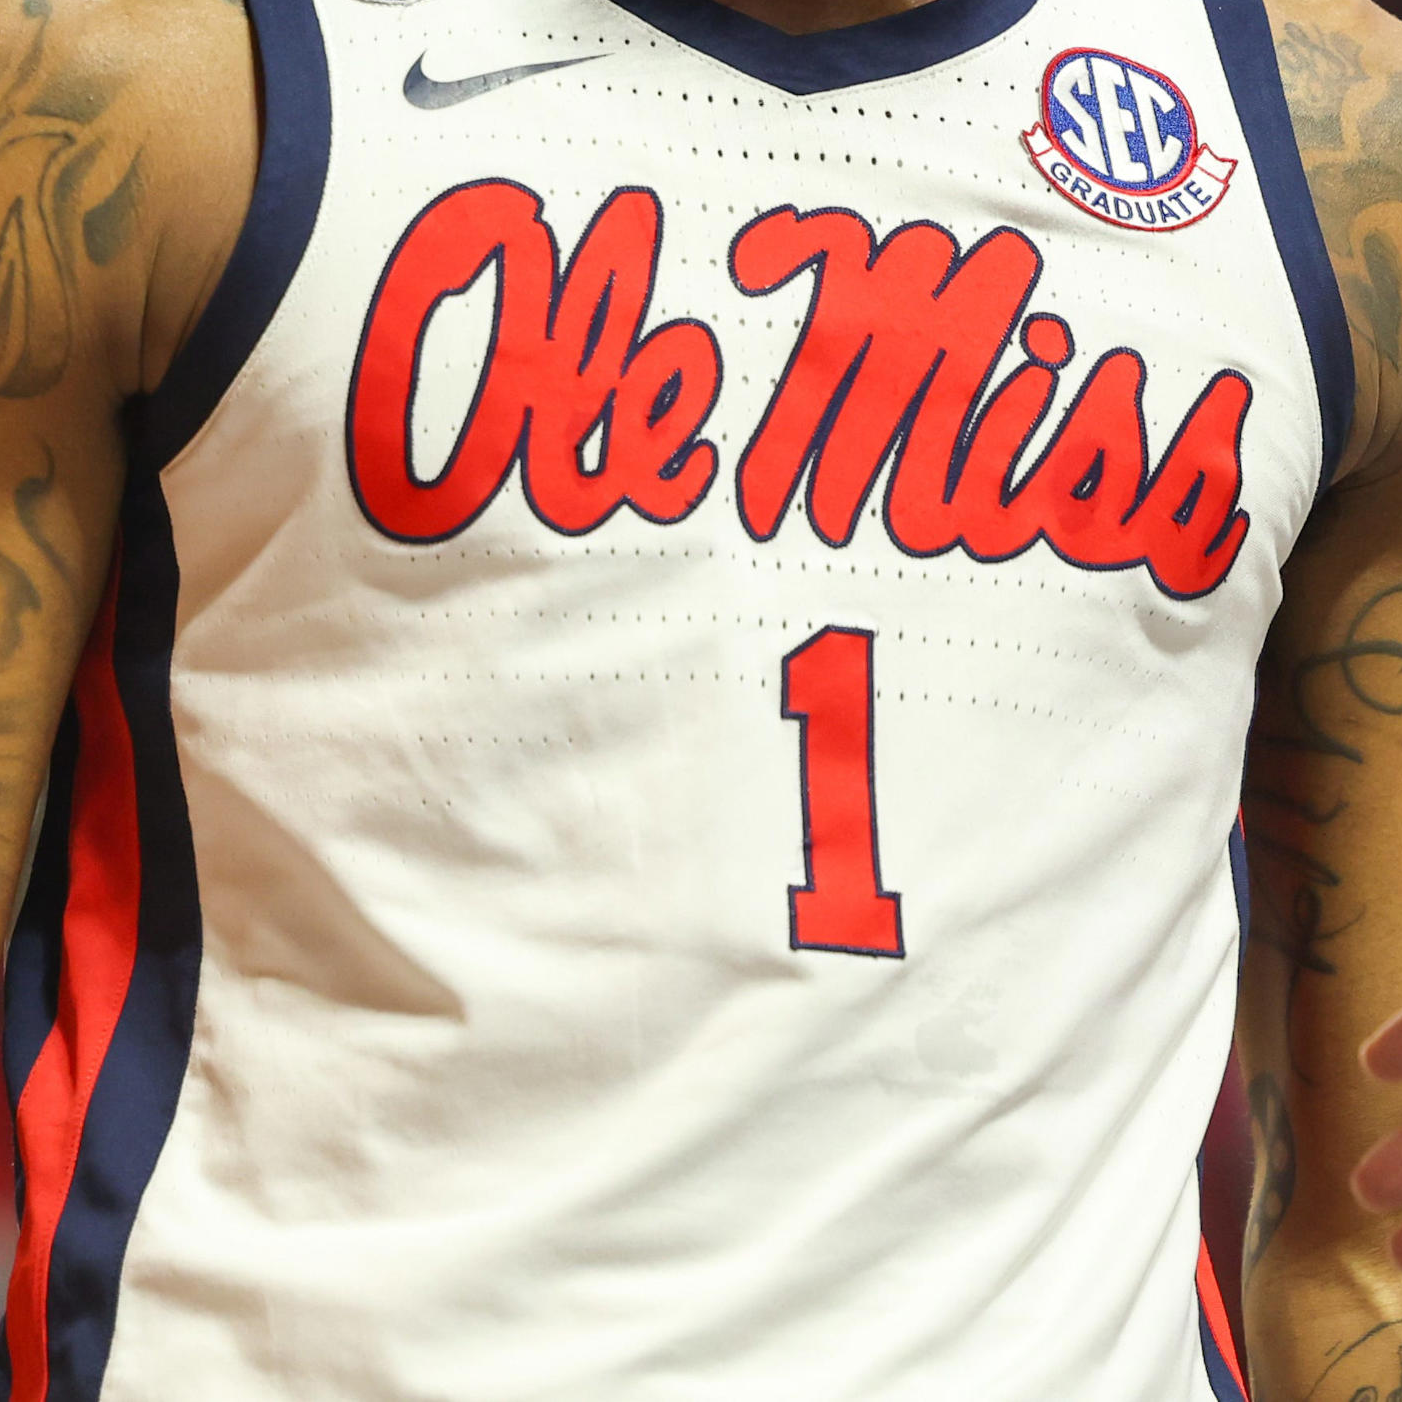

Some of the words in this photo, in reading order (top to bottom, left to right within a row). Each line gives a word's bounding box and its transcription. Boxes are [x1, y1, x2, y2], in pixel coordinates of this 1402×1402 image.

[1049, 161, 1214, 225] GRADUATE
[1051, 55, 1185, 184] SEC
[346, 177, 723, 544] Ole
[728, 203, 1253, 600] Miss
[780, 625, 905, 959] 1
